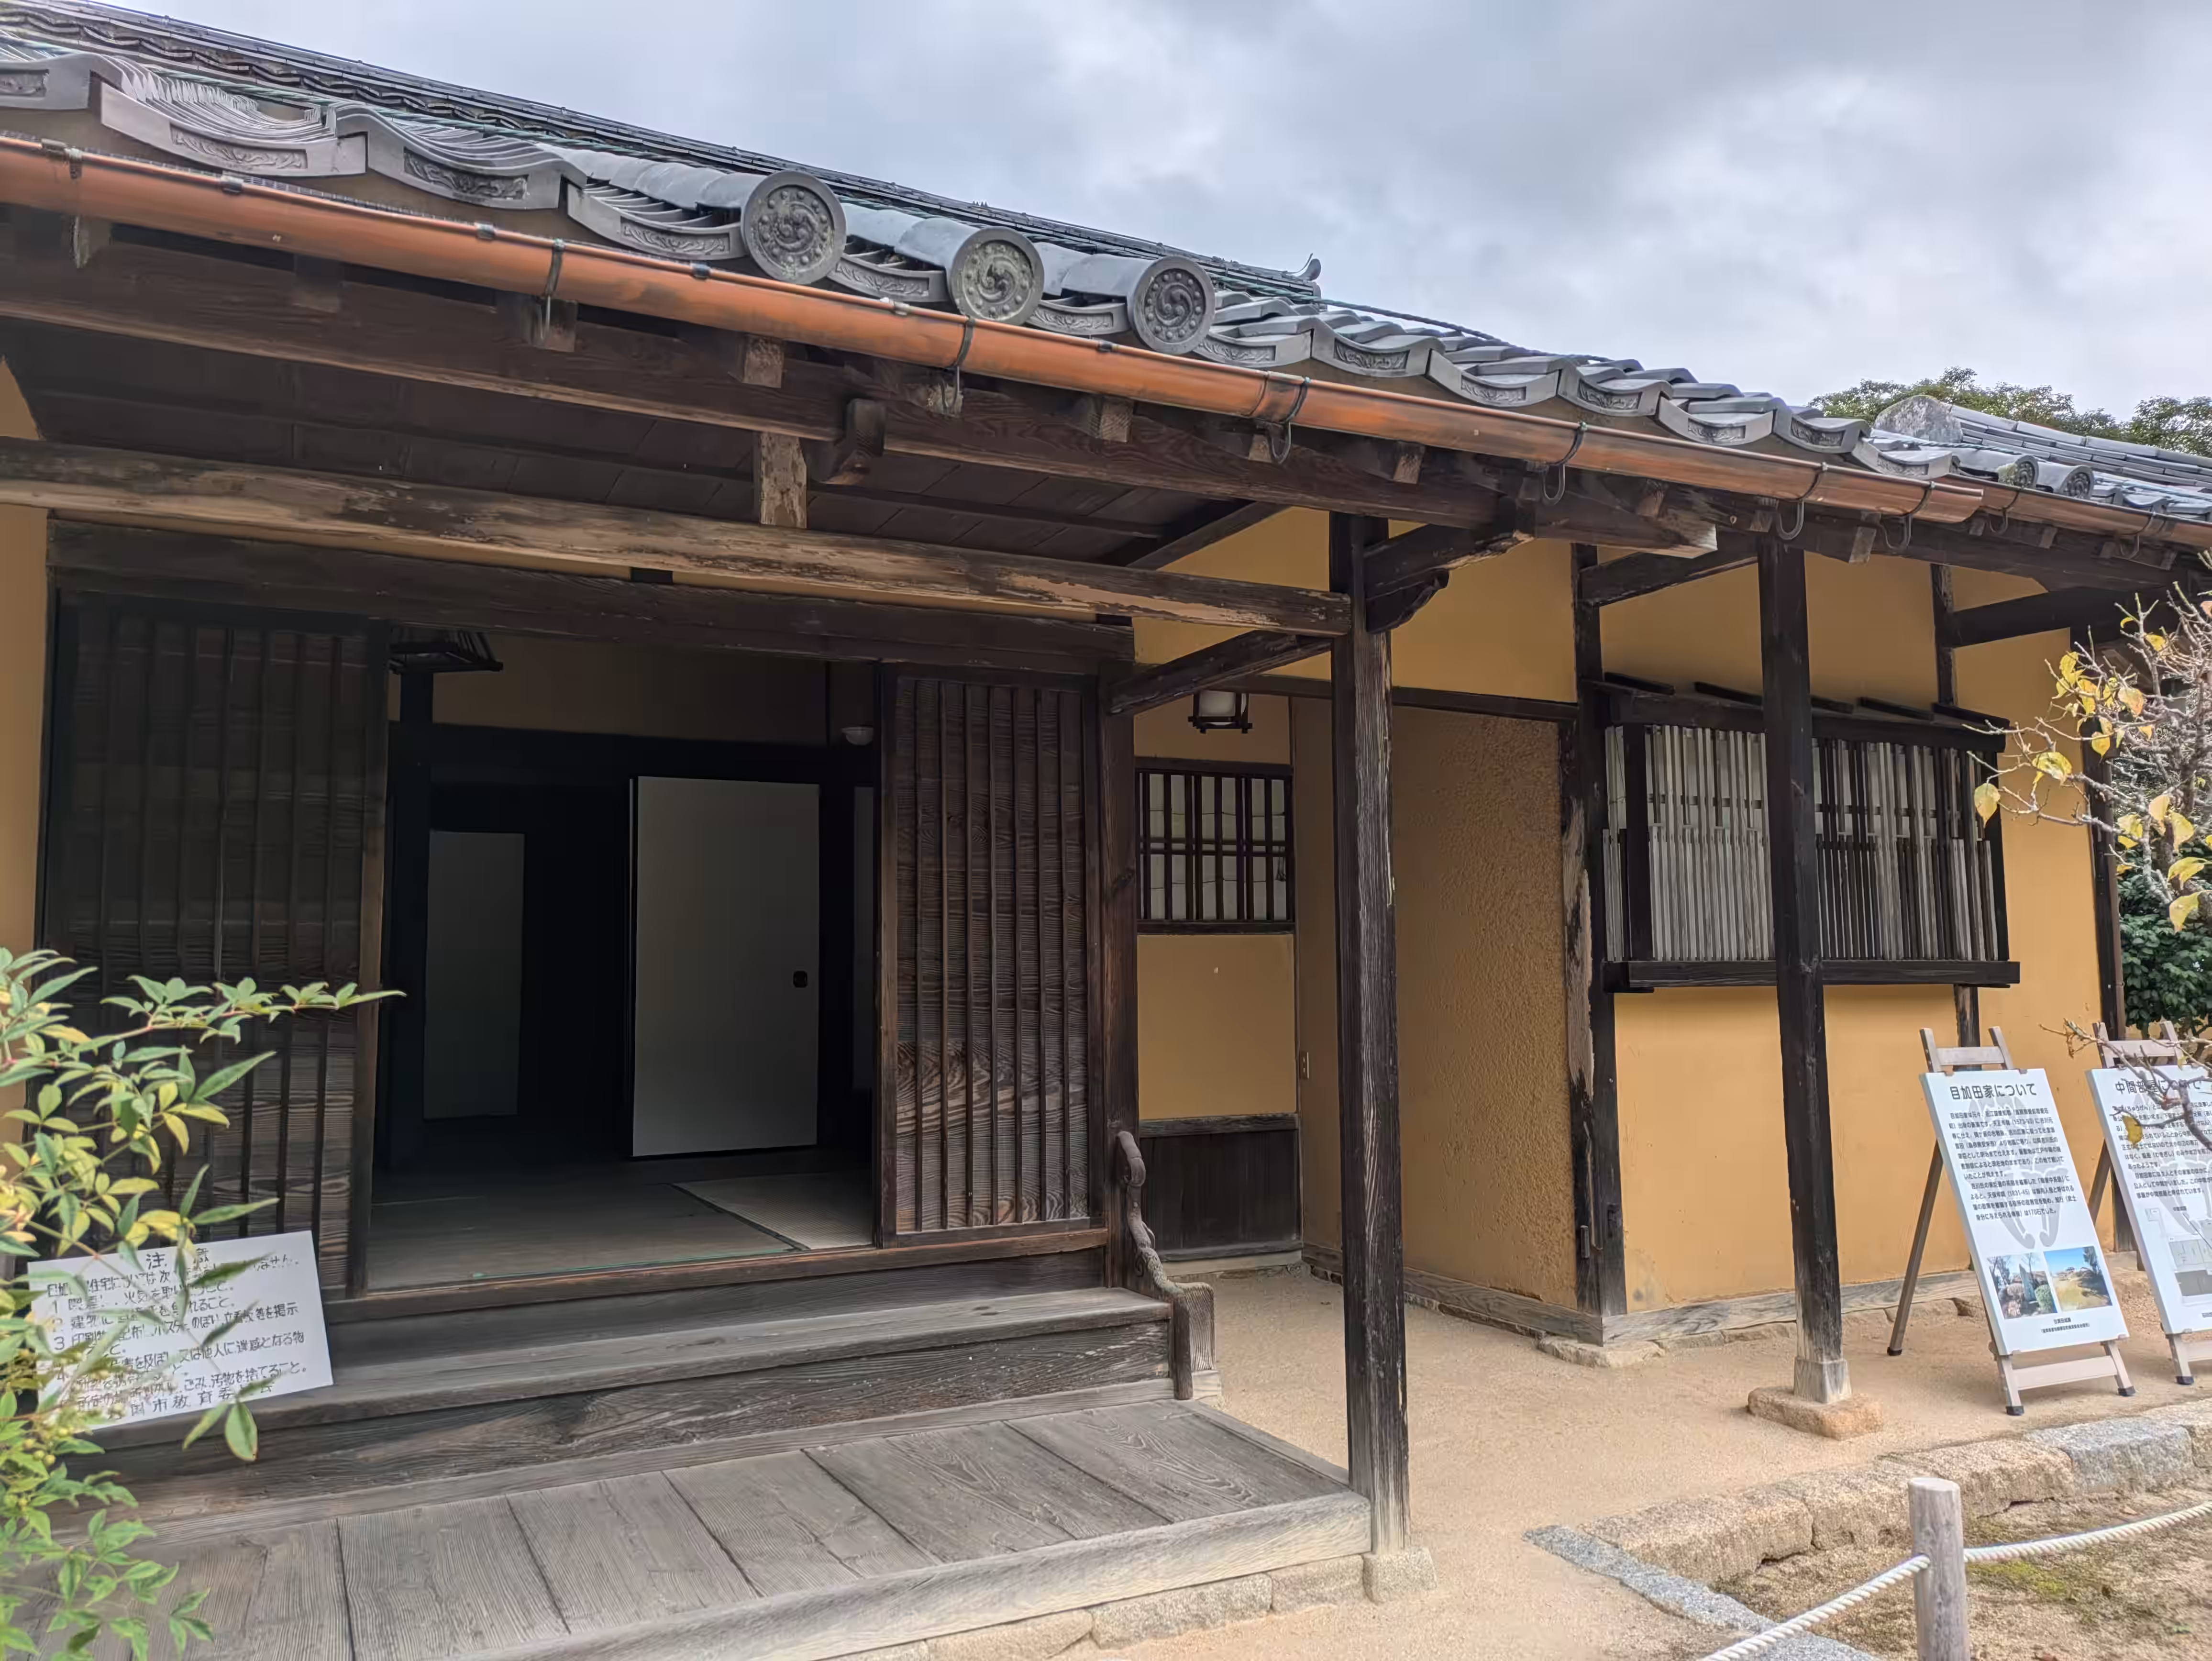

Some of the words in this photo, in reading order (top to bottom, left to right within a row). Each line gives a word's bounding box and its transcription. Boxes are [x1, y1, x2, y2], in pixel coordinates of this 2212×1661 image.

[1950, 1084, 2037, 1099] 目加田家について
[2115, 1079, 2201, 1094] 中間部屋にて
[54, 1336, 65, 1351] 3
